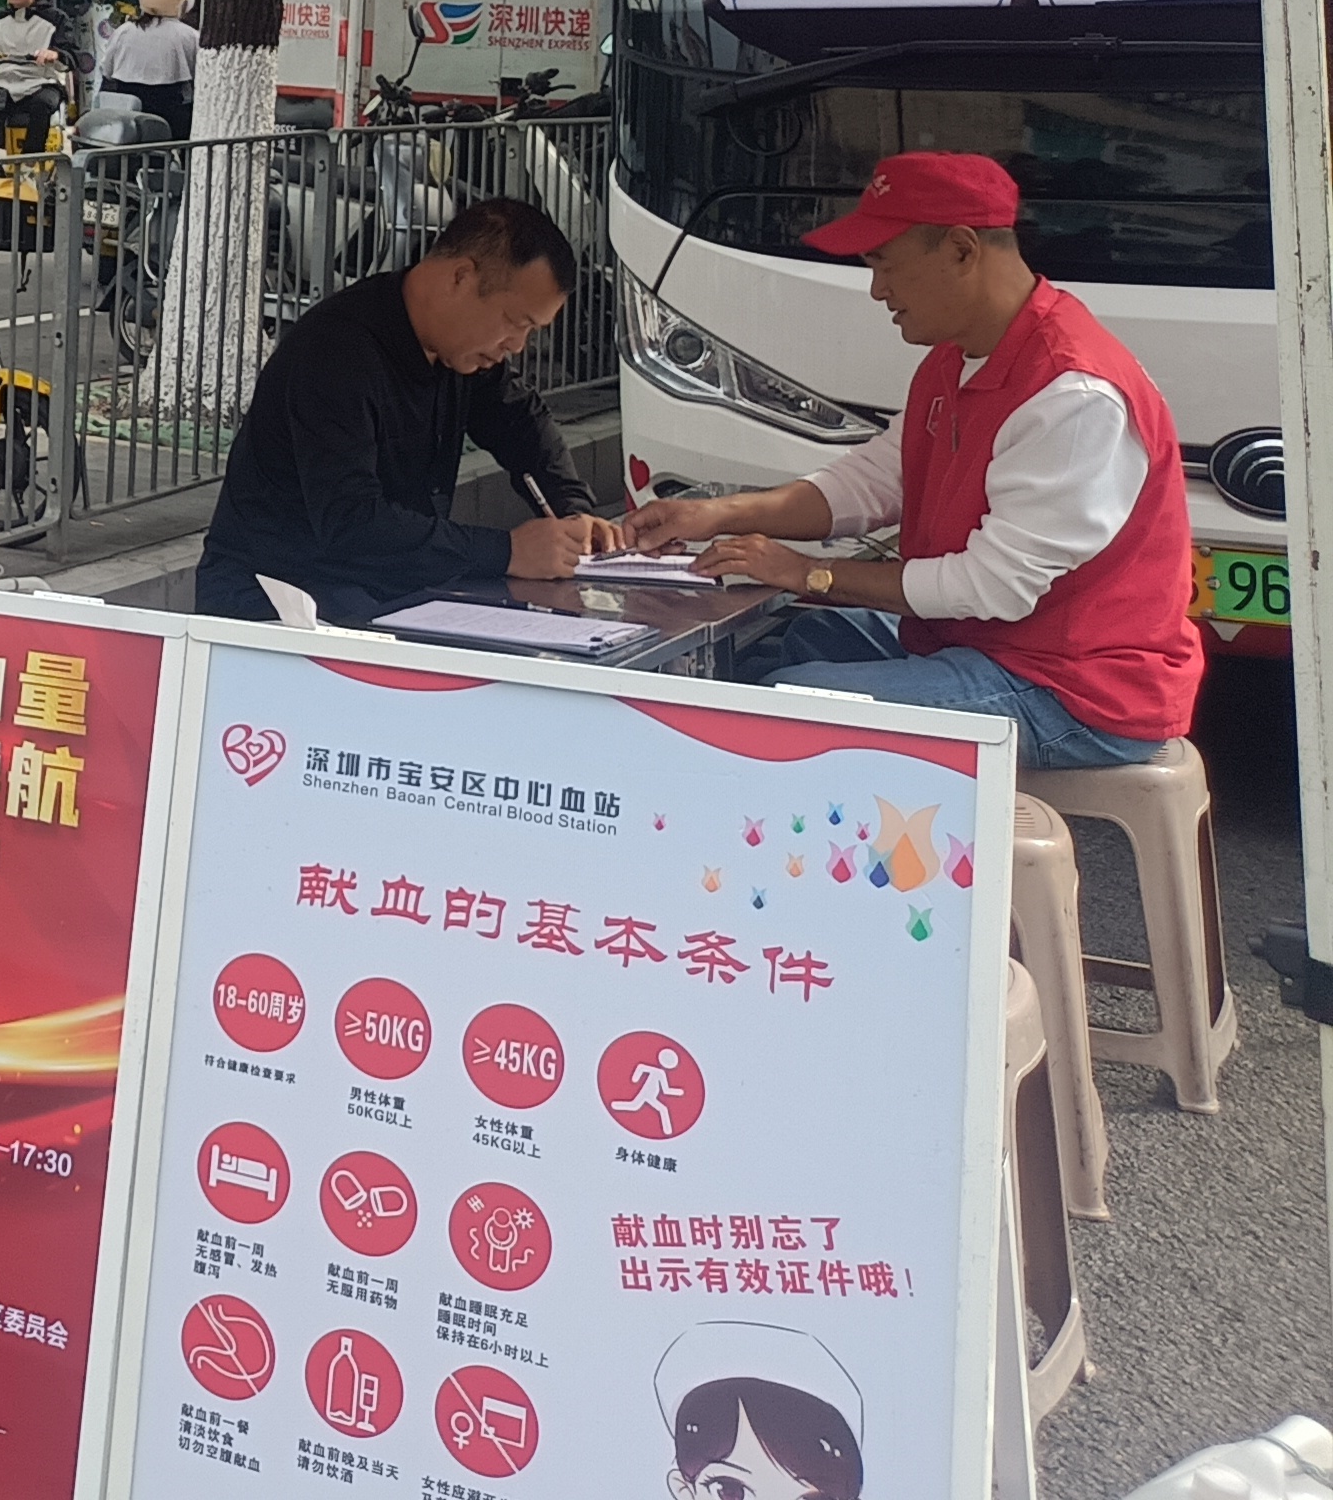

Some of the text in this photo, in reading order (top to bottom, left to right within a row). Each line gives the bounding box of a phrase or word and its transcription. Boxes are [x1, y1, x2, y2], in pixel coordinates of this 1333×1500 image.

[488, 3, 591, 37] 深圳快递
[487, 36, 590, 51] SHENZHEN EXPRESS
[306, 746, 621, 819] 深圳市宝安区中心血站
[302, 773, 617, 836] Shenzhen Baoan Central Blood Station
[296, 861, 835, 1002] 献血的基本条件
[217, 983, 305, 1025] 18-60周岁
[204, 1054, 296, 1084] 符合健康检查要求
[350, 1086, 406, 1111] 男性体重
[347, 1103, 413, 1130] 50KG以上
[474, 1115, 534, 1141] 女性体重
[472, 1131, 541, 1159] 45KG以上
[615, 1146, 677, 1173] 身体健康
[196, 1229, 264, 1259] 献血前一周
[611, 1213, 840, 1251] 献血时别忘了
[193, 1260, 221, 1280] 腹泻
[195, 1244, 278, 1278] 无感冒、发热
[328, 1263, 399, 1294] 献血前一周
[325, 1280, 398, 1310] 无服用药物
[439, 1292, 529, 1328] 献血睡眠充足
[437, 1308, 497, 1337] 睡眠时间
[436, 1326, 550, 1369] 保持在6小时以上
[179, 1419, 234, 1448] 清淡饮食
[181, 1403, 250, 1436] 献血前一餐
[178, 1436, 261, 1473] 切勿空腹献血
[298, 1438, 400, 1480] 献血前晚及当天
[297, 1455, 354, 1485] 请勿饮酒
